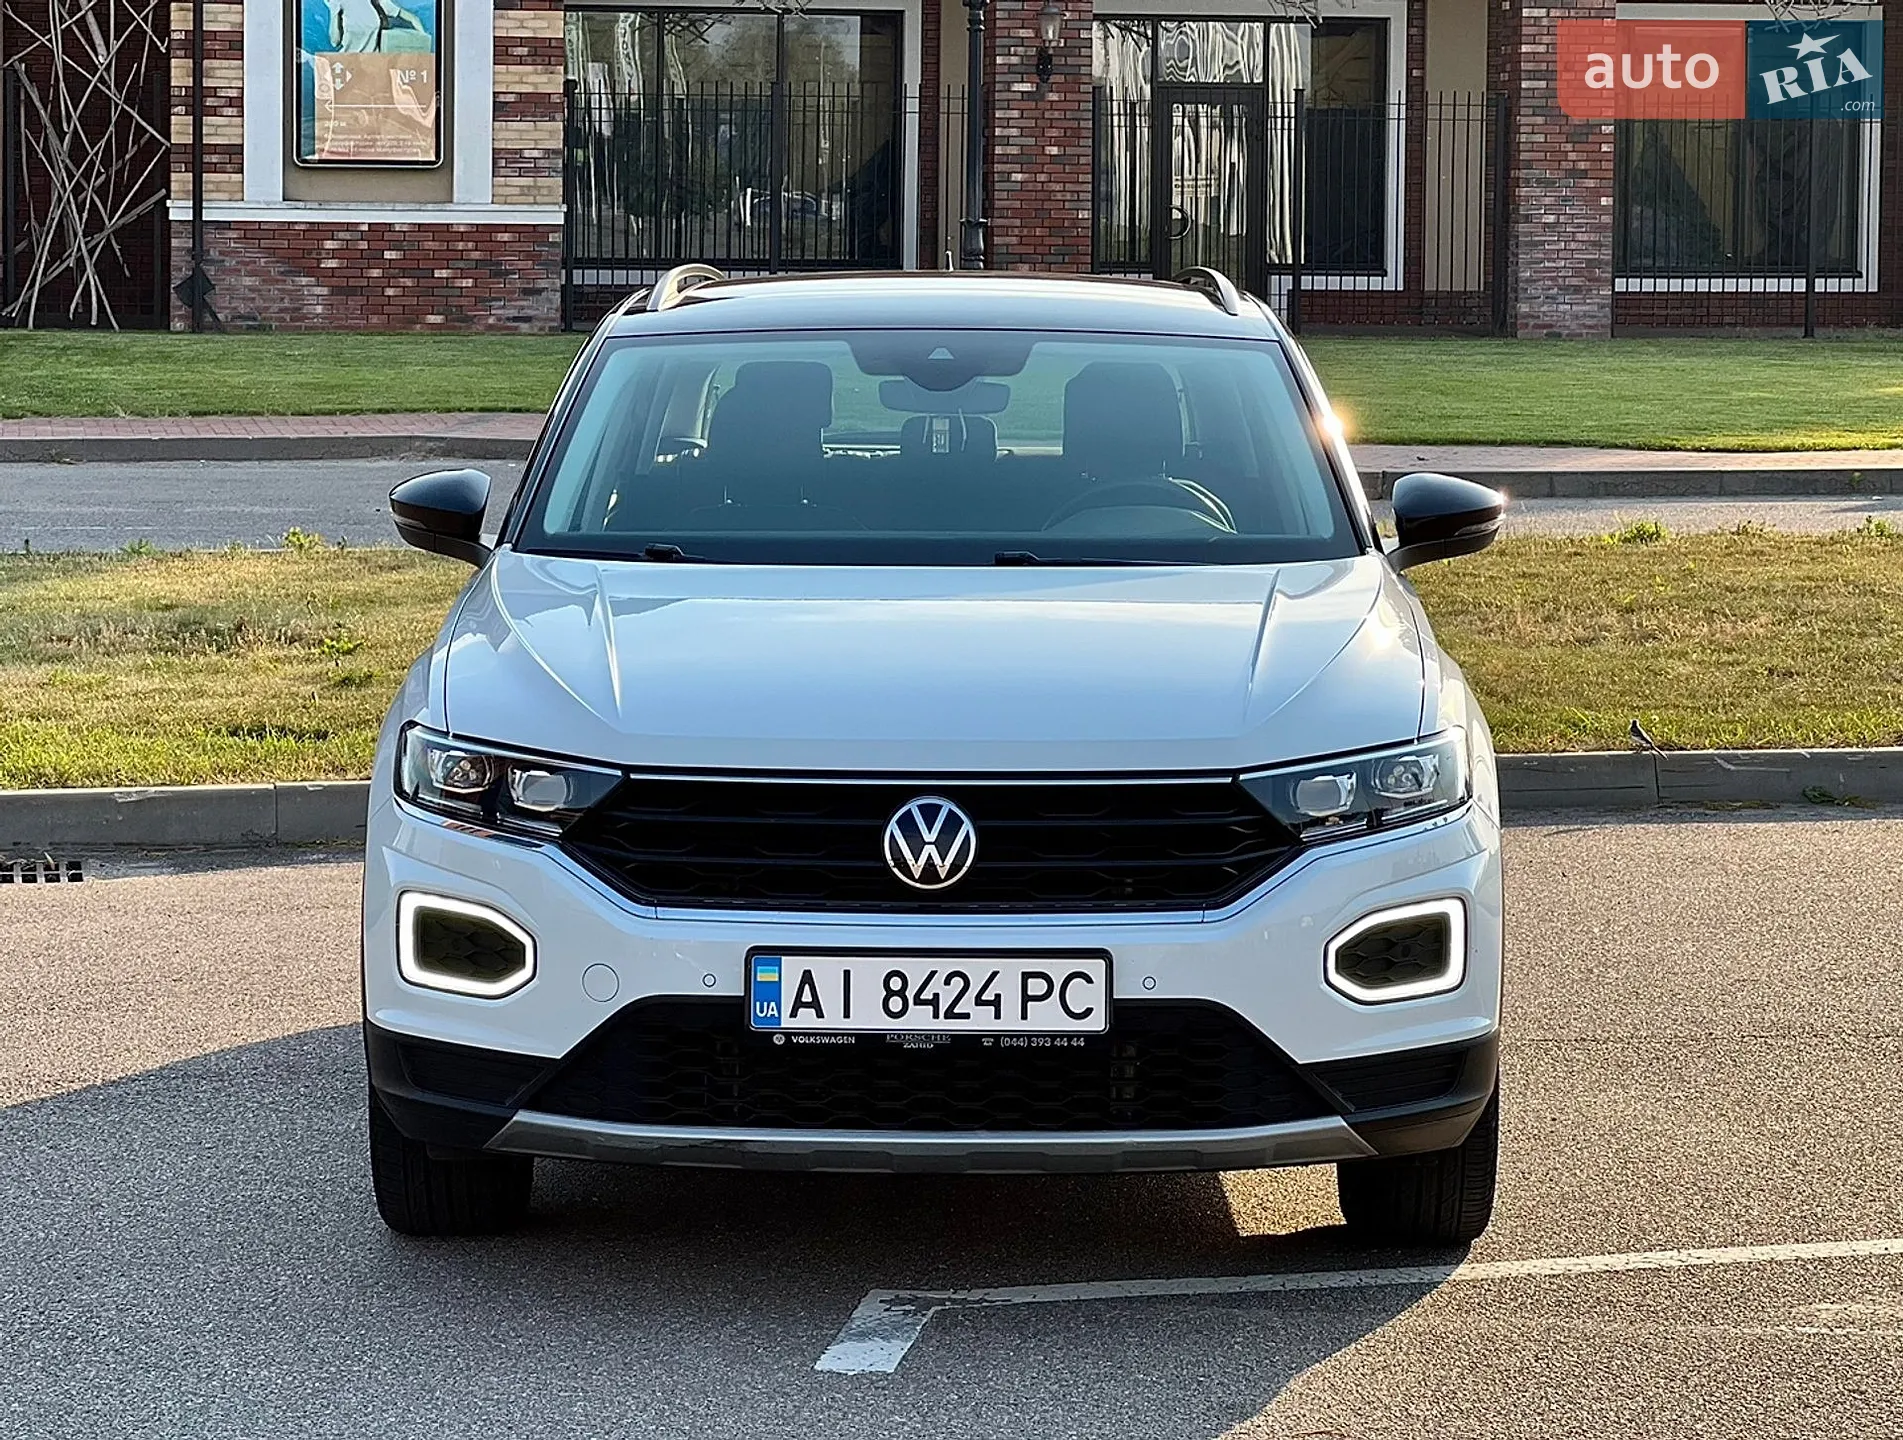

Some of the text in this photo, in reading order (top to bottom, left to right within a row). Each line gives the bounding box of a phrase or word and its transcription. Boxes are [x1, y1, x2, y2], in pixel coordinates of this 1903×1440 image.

[421, 70, 428, 83] 1
[881, 969, 1002, 1020] 8424
[1020, 970, 1095, 1021] PC
[755, 1001, 779, 1018] UA
[791, 1035, 856, 1045] VOLKSWAGEN
[886, 1033, 951, 1043] PORSCHE
[1000, 1037, 1086, 1048] (044) 393 44 44
